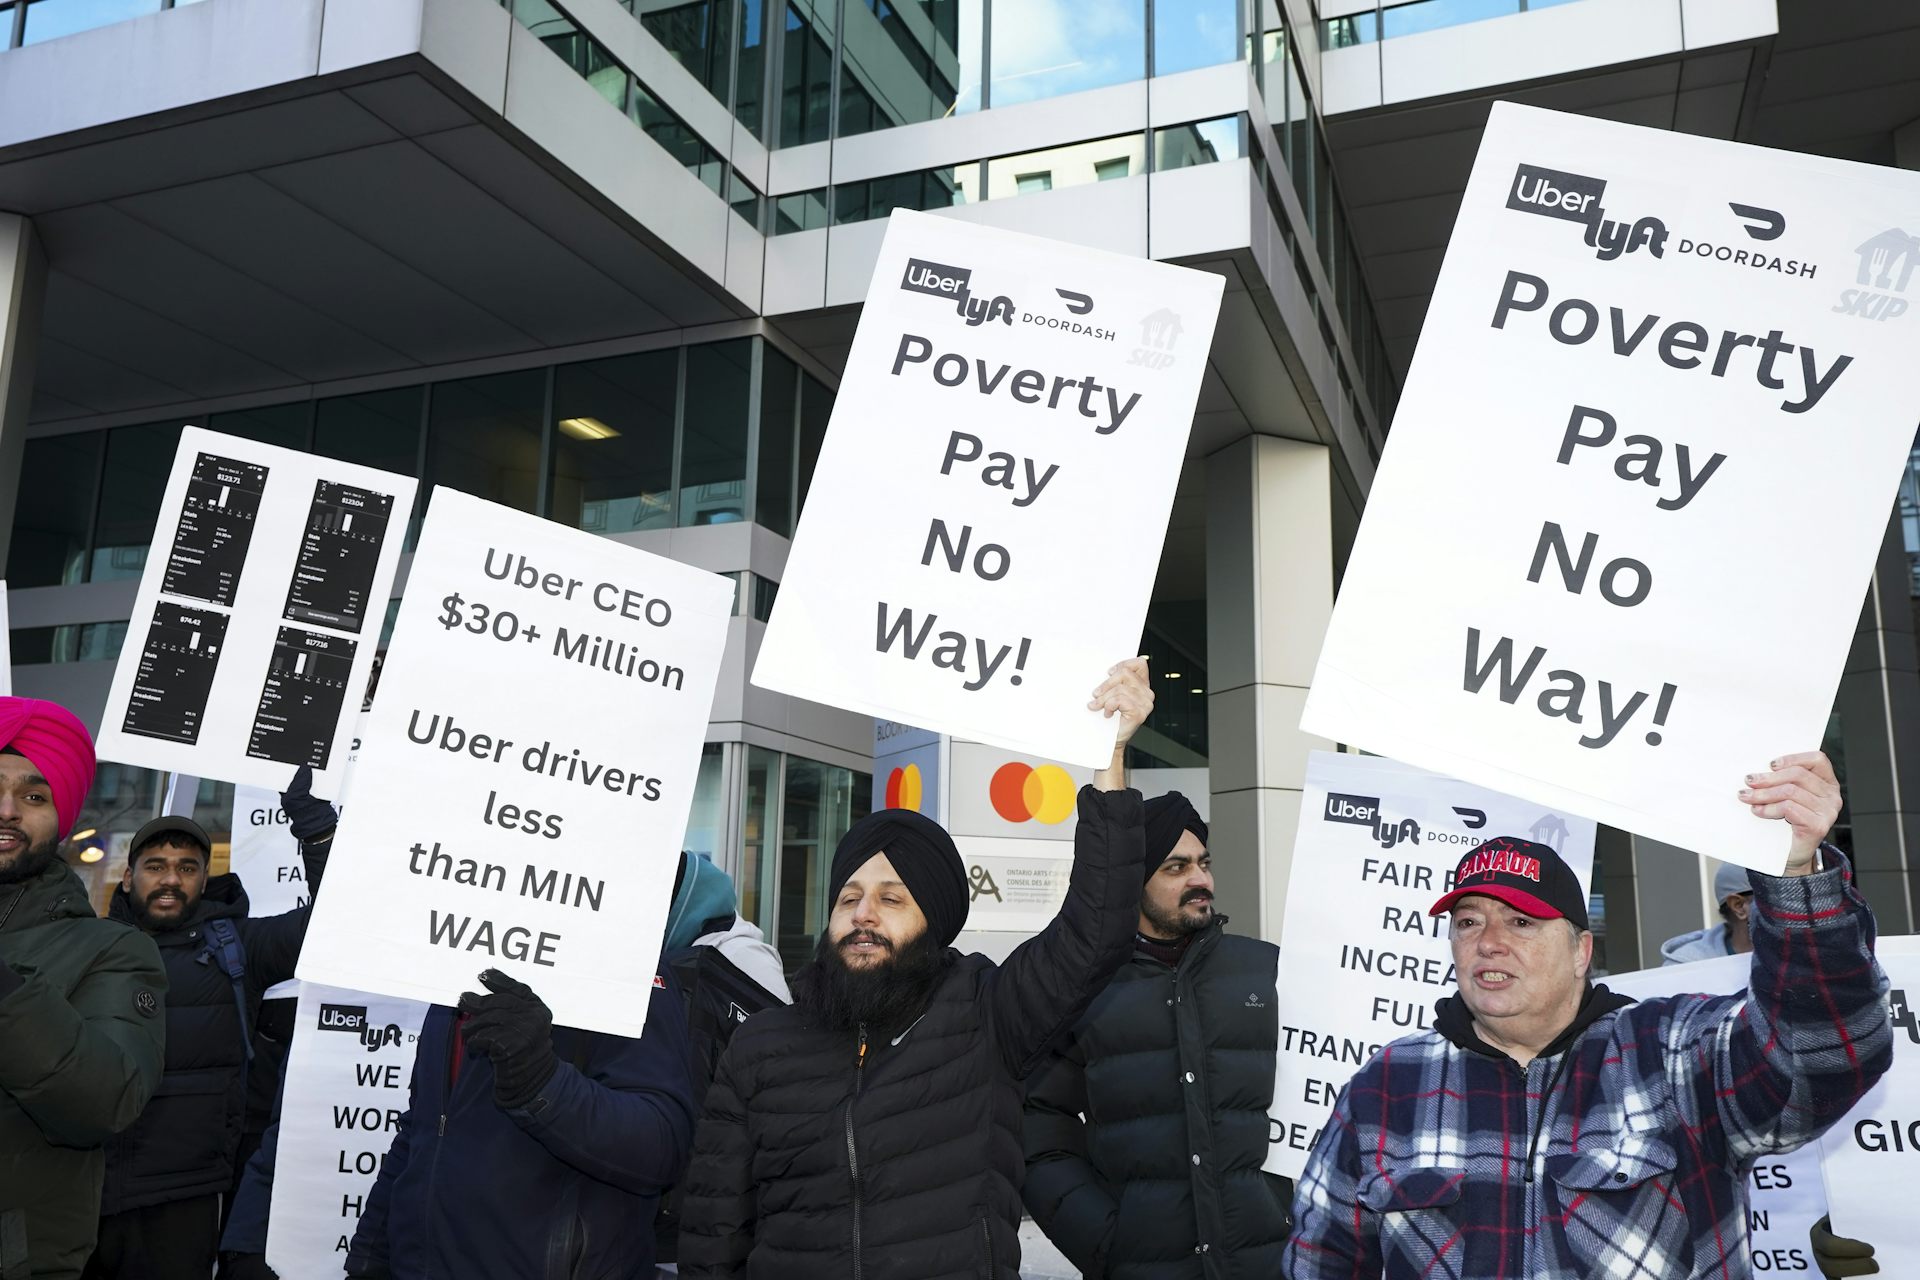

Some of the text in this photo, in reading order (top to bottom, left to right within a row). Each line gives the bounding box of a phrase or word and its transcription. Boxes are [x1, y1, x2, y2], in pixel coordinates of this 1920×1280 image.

[1515, 174, 1597, 214] Uber
[1583, 207, 1670, 262] lyft
[907, 265, 965, 293] Uber
[1678, 239, 1817, 279] DOORDASH
[956, 287, 1016, 327] lyft
[1831, 288, 1909, 322] SKIP
[1022, 313, 1116, 342] DOORDASH
[1491, 270, 1854, 413] Poverty
[892, 334, 1142, 435] Poverty
[940, 431, 1060, 507] Pay
[1557, 405, 1727, 510] Pay
[217, 473, 241, 485] $123.71
[172, 554, 201, 564] Breakdown
[921, 519, 1010, 581] No
[1527, 521, 1652, 607] No
[485, 548, 672, 627] Uber CEO
[180, 616, 201, 626] $74.42
[438, 593, 684, 690] $30+ Million
[877, 602, 1032, 691] Way!
[133, 692, 161, 701] Breakdown
[1464, 627, 1677, 749] Way!
[256, 722, 284, 732] Breakdown
[408, 710, 662, 801] Uber drivers
[484, 791, 564, 839] less
[1327, 798, 1377, 821] Uber
[1372, 814, 1421, 849] lyft
[410, 844, 605, 911] than MIN
[1362, 858, 1433, 891] FAIR
[1457, 848, 1541, 885] CANADA
[430, 910, 560, 966] WAGE
[322, 1009, 363, 1027] Uber
[360, 1022, 402, 1052] lyft
[356, 1063, 401, 1089] WE
